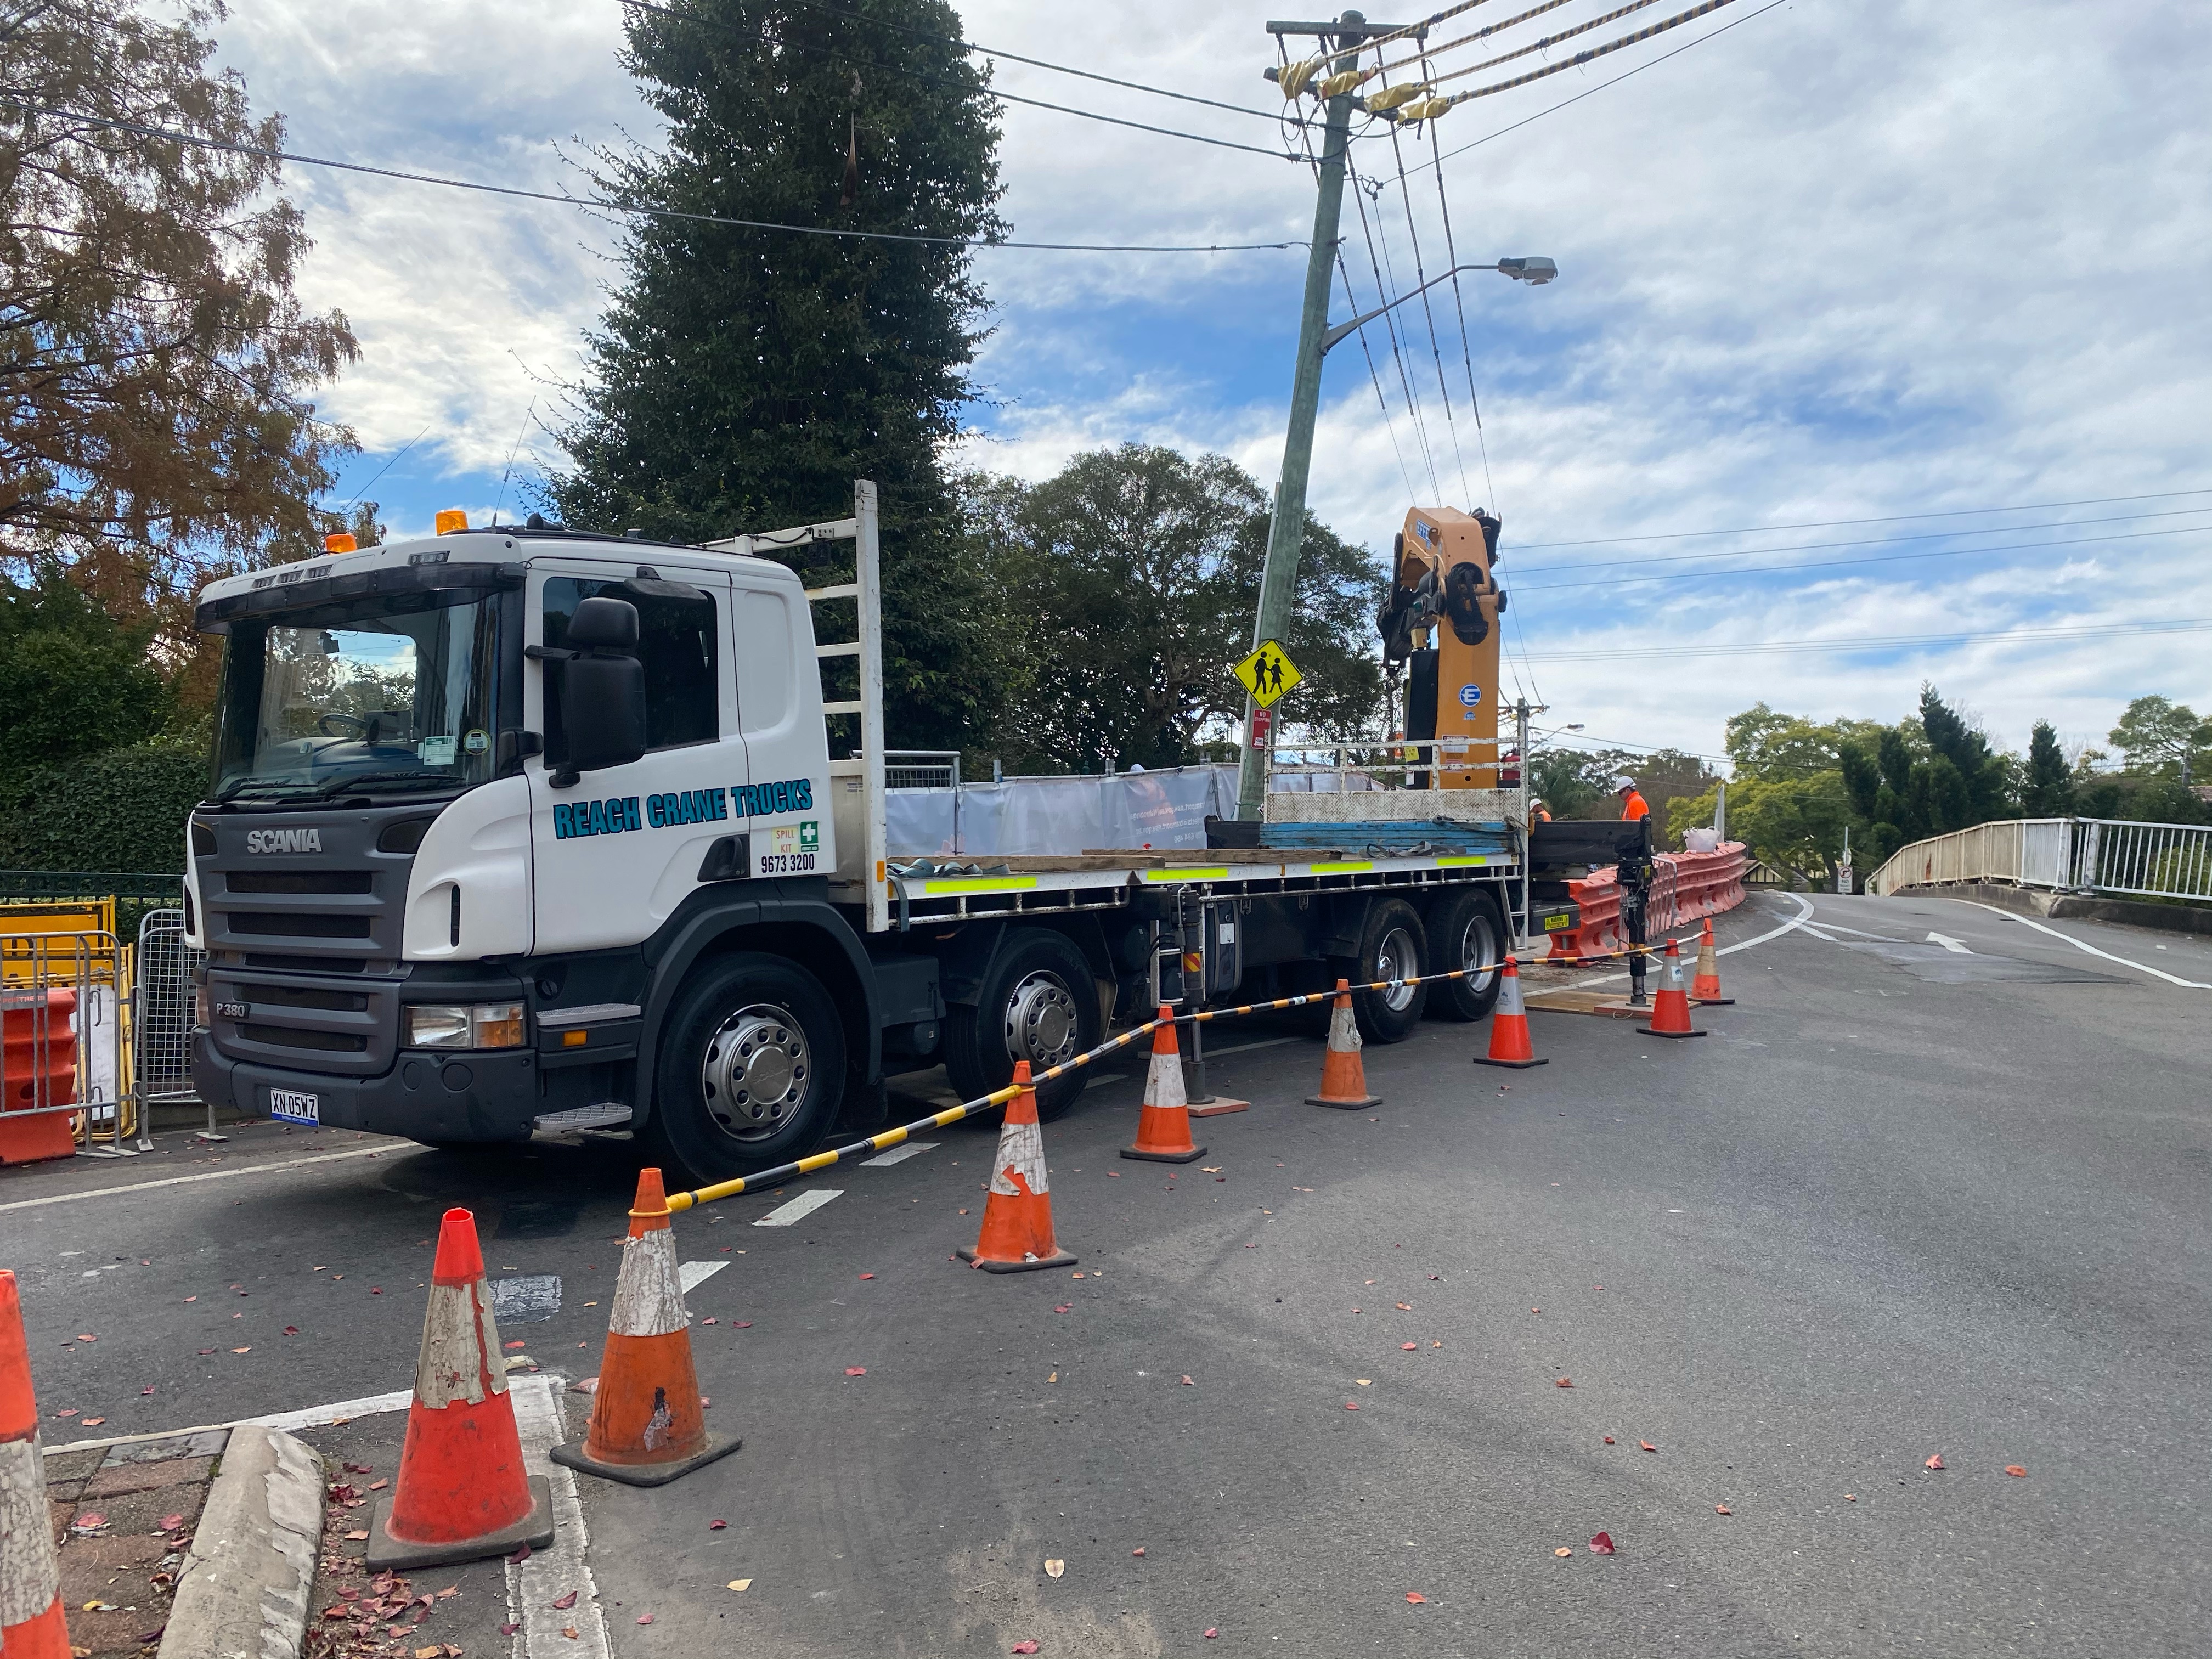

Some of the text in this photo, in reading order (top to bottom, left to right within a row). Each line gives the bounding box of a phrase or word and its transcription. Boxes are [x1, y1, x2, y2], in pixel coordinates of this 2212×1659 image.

[1417, 520, 1430, 541] EFFE
[553, 778, 813, 840] REACH CRANE TRUCKS
[247, 829, 323, 854] SCANIA
[776, 830, 795, 839] SPILL
[781, 844, 792, 853] KIT
[761, 853, 815, 873] 9673 3200
[216, 1003, 245, 1017] P 380
